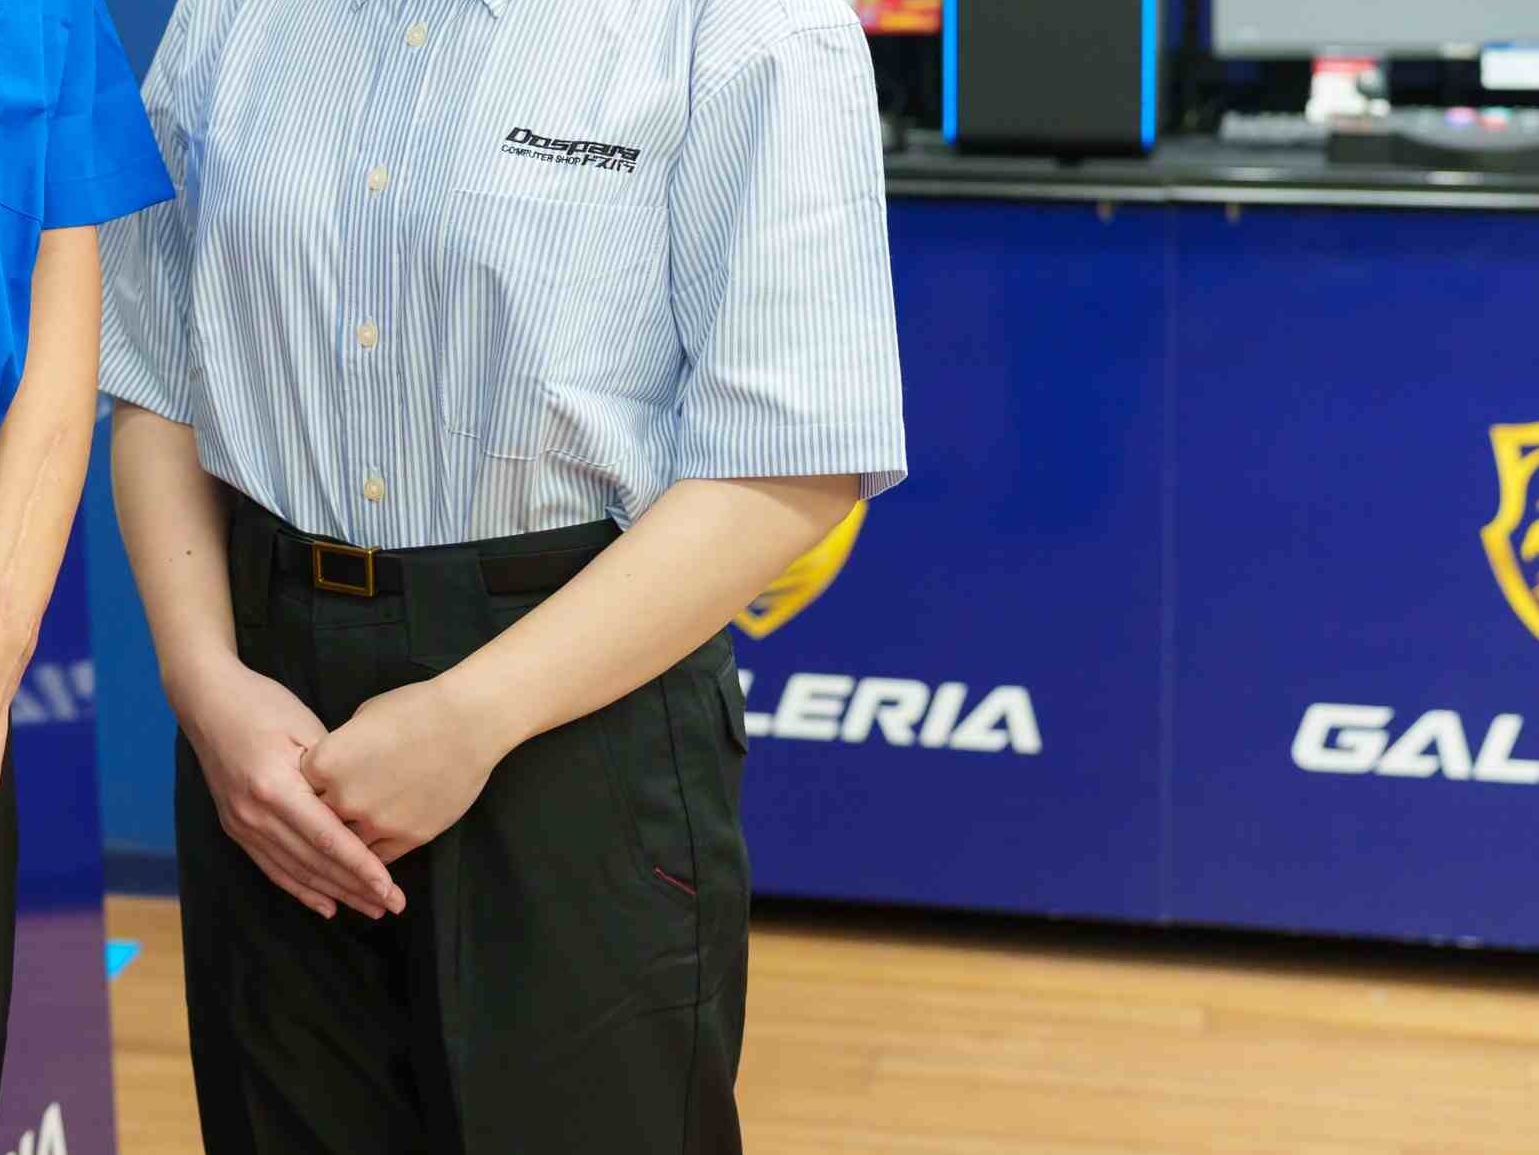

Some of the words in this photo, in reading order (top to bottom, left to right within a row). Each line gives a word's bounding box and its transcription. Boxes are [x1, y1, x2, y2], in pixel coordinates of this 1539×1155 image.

[501, 144, 554, 163] COMPUTER
[555, 154, 581, 166] SHOP
[505, 126, 641, 161] Dospara
